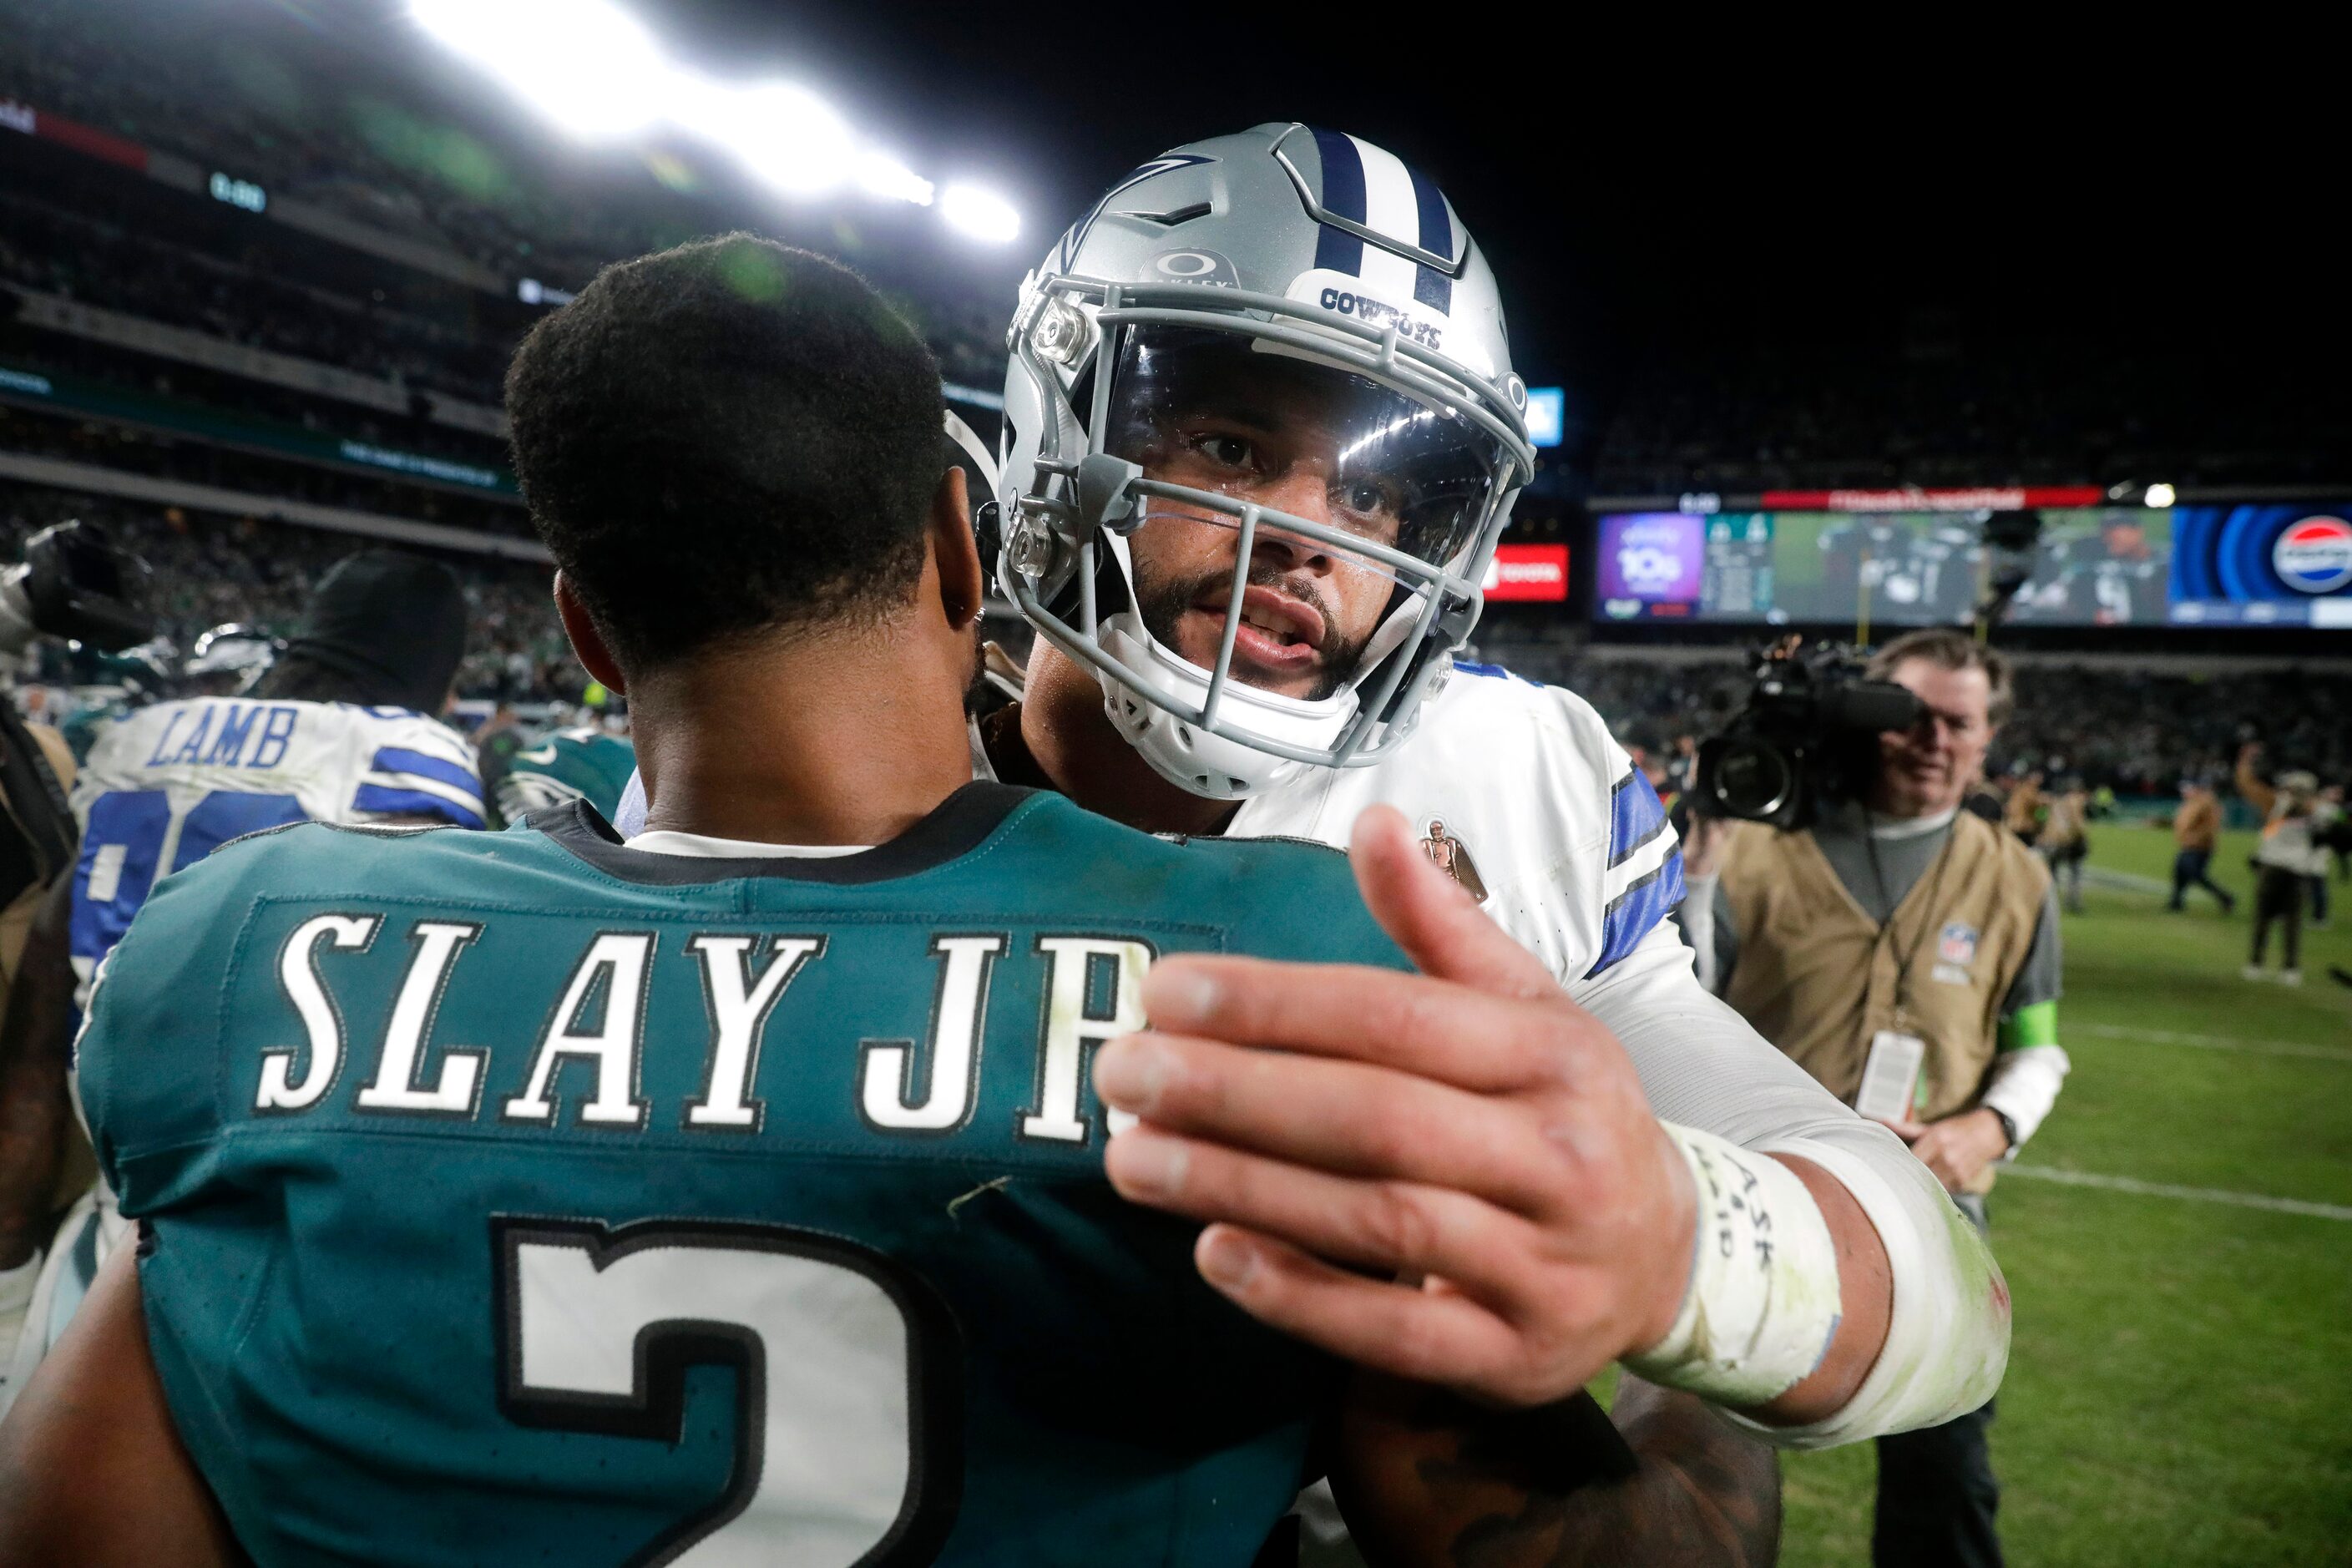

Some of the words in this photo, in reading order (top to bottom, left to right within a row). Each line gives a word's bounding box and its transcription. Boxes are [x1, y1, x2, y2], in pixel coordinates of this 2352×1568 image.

[145, 705, 301, 769] LAMB
[255, 912, 828, 1132] SLAY
[854, 931, 1162, 1146] JR
[488, 1211, 965, 1568] 2
